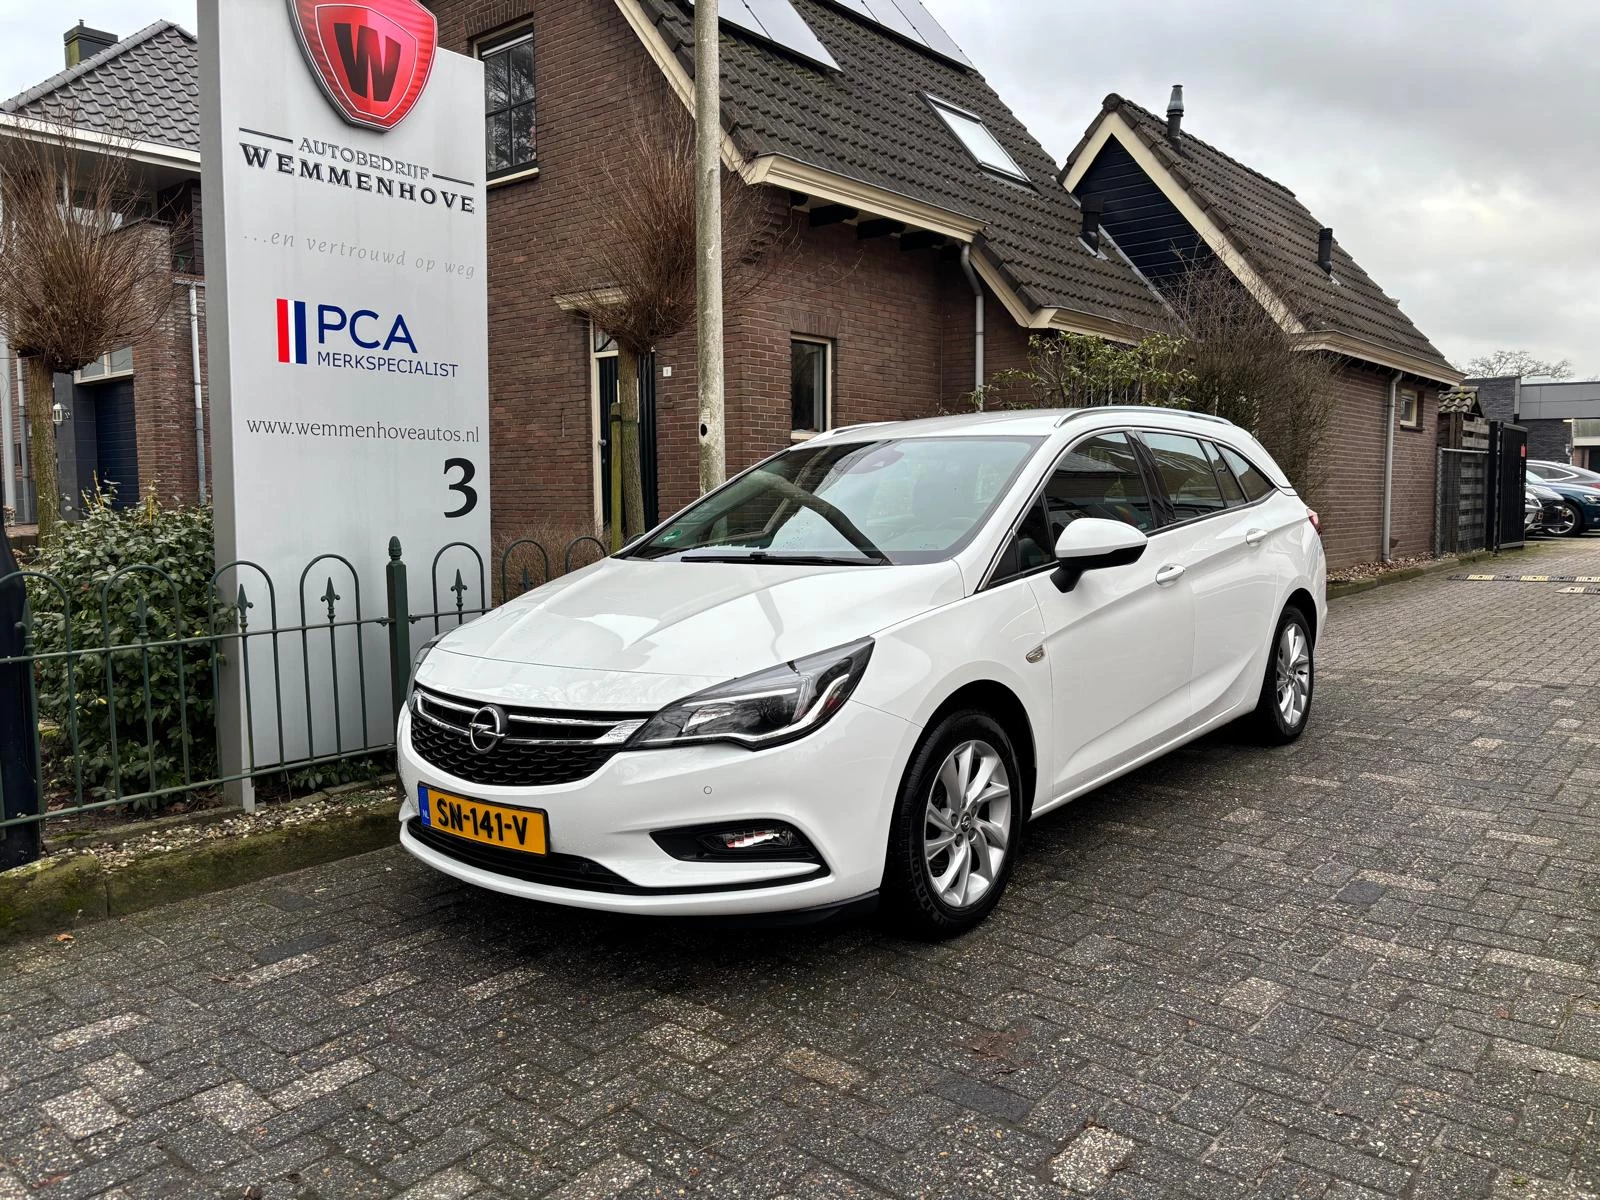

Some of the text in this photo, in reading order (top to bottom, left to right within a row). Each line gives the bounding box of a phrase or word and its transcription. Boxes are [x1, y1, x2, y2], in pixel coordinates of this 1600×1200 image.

[333, 22, 402, 102] W
[239, 142, 475, 214] WEMMENHOVE
[299, 137, 430, 180] AUTOBEDRIJF
[306, 237, 406, 266] vertrouwd
[415, 256, 436, 272] op
[444, 261, 475, 280] weg
[317, 303, 419, 354] PCA
[317, 351, 459, 378] MERKSPECIALIST
[246, 418, 480, 443] www.wemmenhoveautos.nl
[442, 456, 479, 519] 3
[422, 809, 430, 819] NL
[436, 797, 529, 846] SN-141-V
